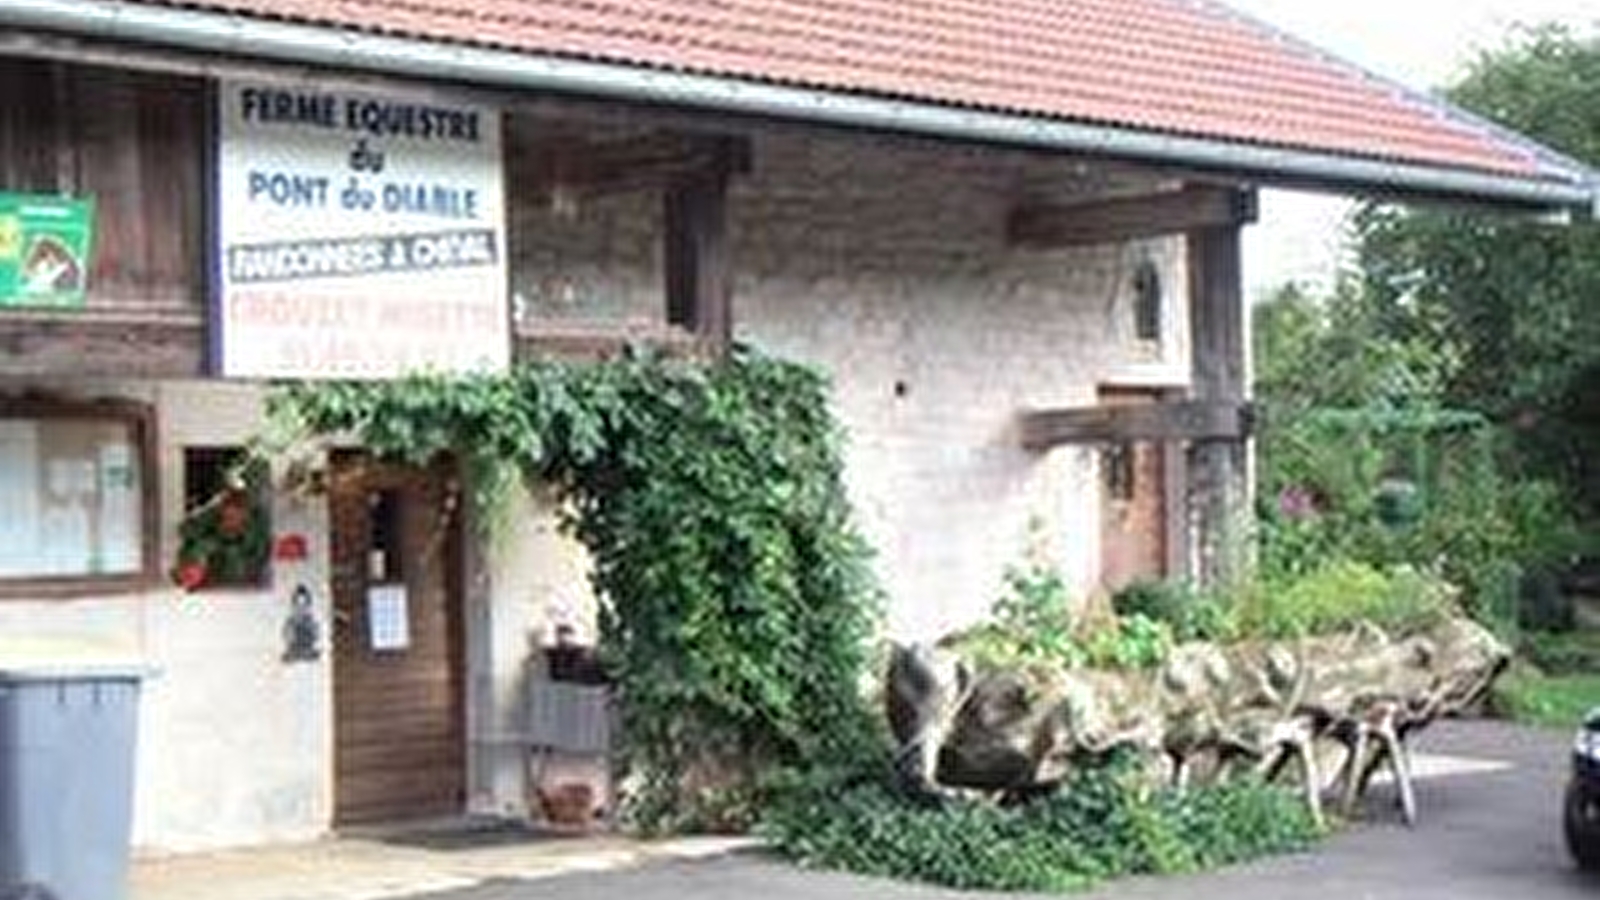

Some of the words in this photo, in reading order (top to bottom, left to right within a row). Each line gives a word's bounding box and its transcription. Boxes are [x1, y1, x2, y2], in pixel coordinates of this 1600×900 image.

[240, 88, 338, 128] FERME
[346, 99, 479, 141] EQUESTRE
[349, 138, 385, 173] du
[249, 173, 330, 206] PONT
